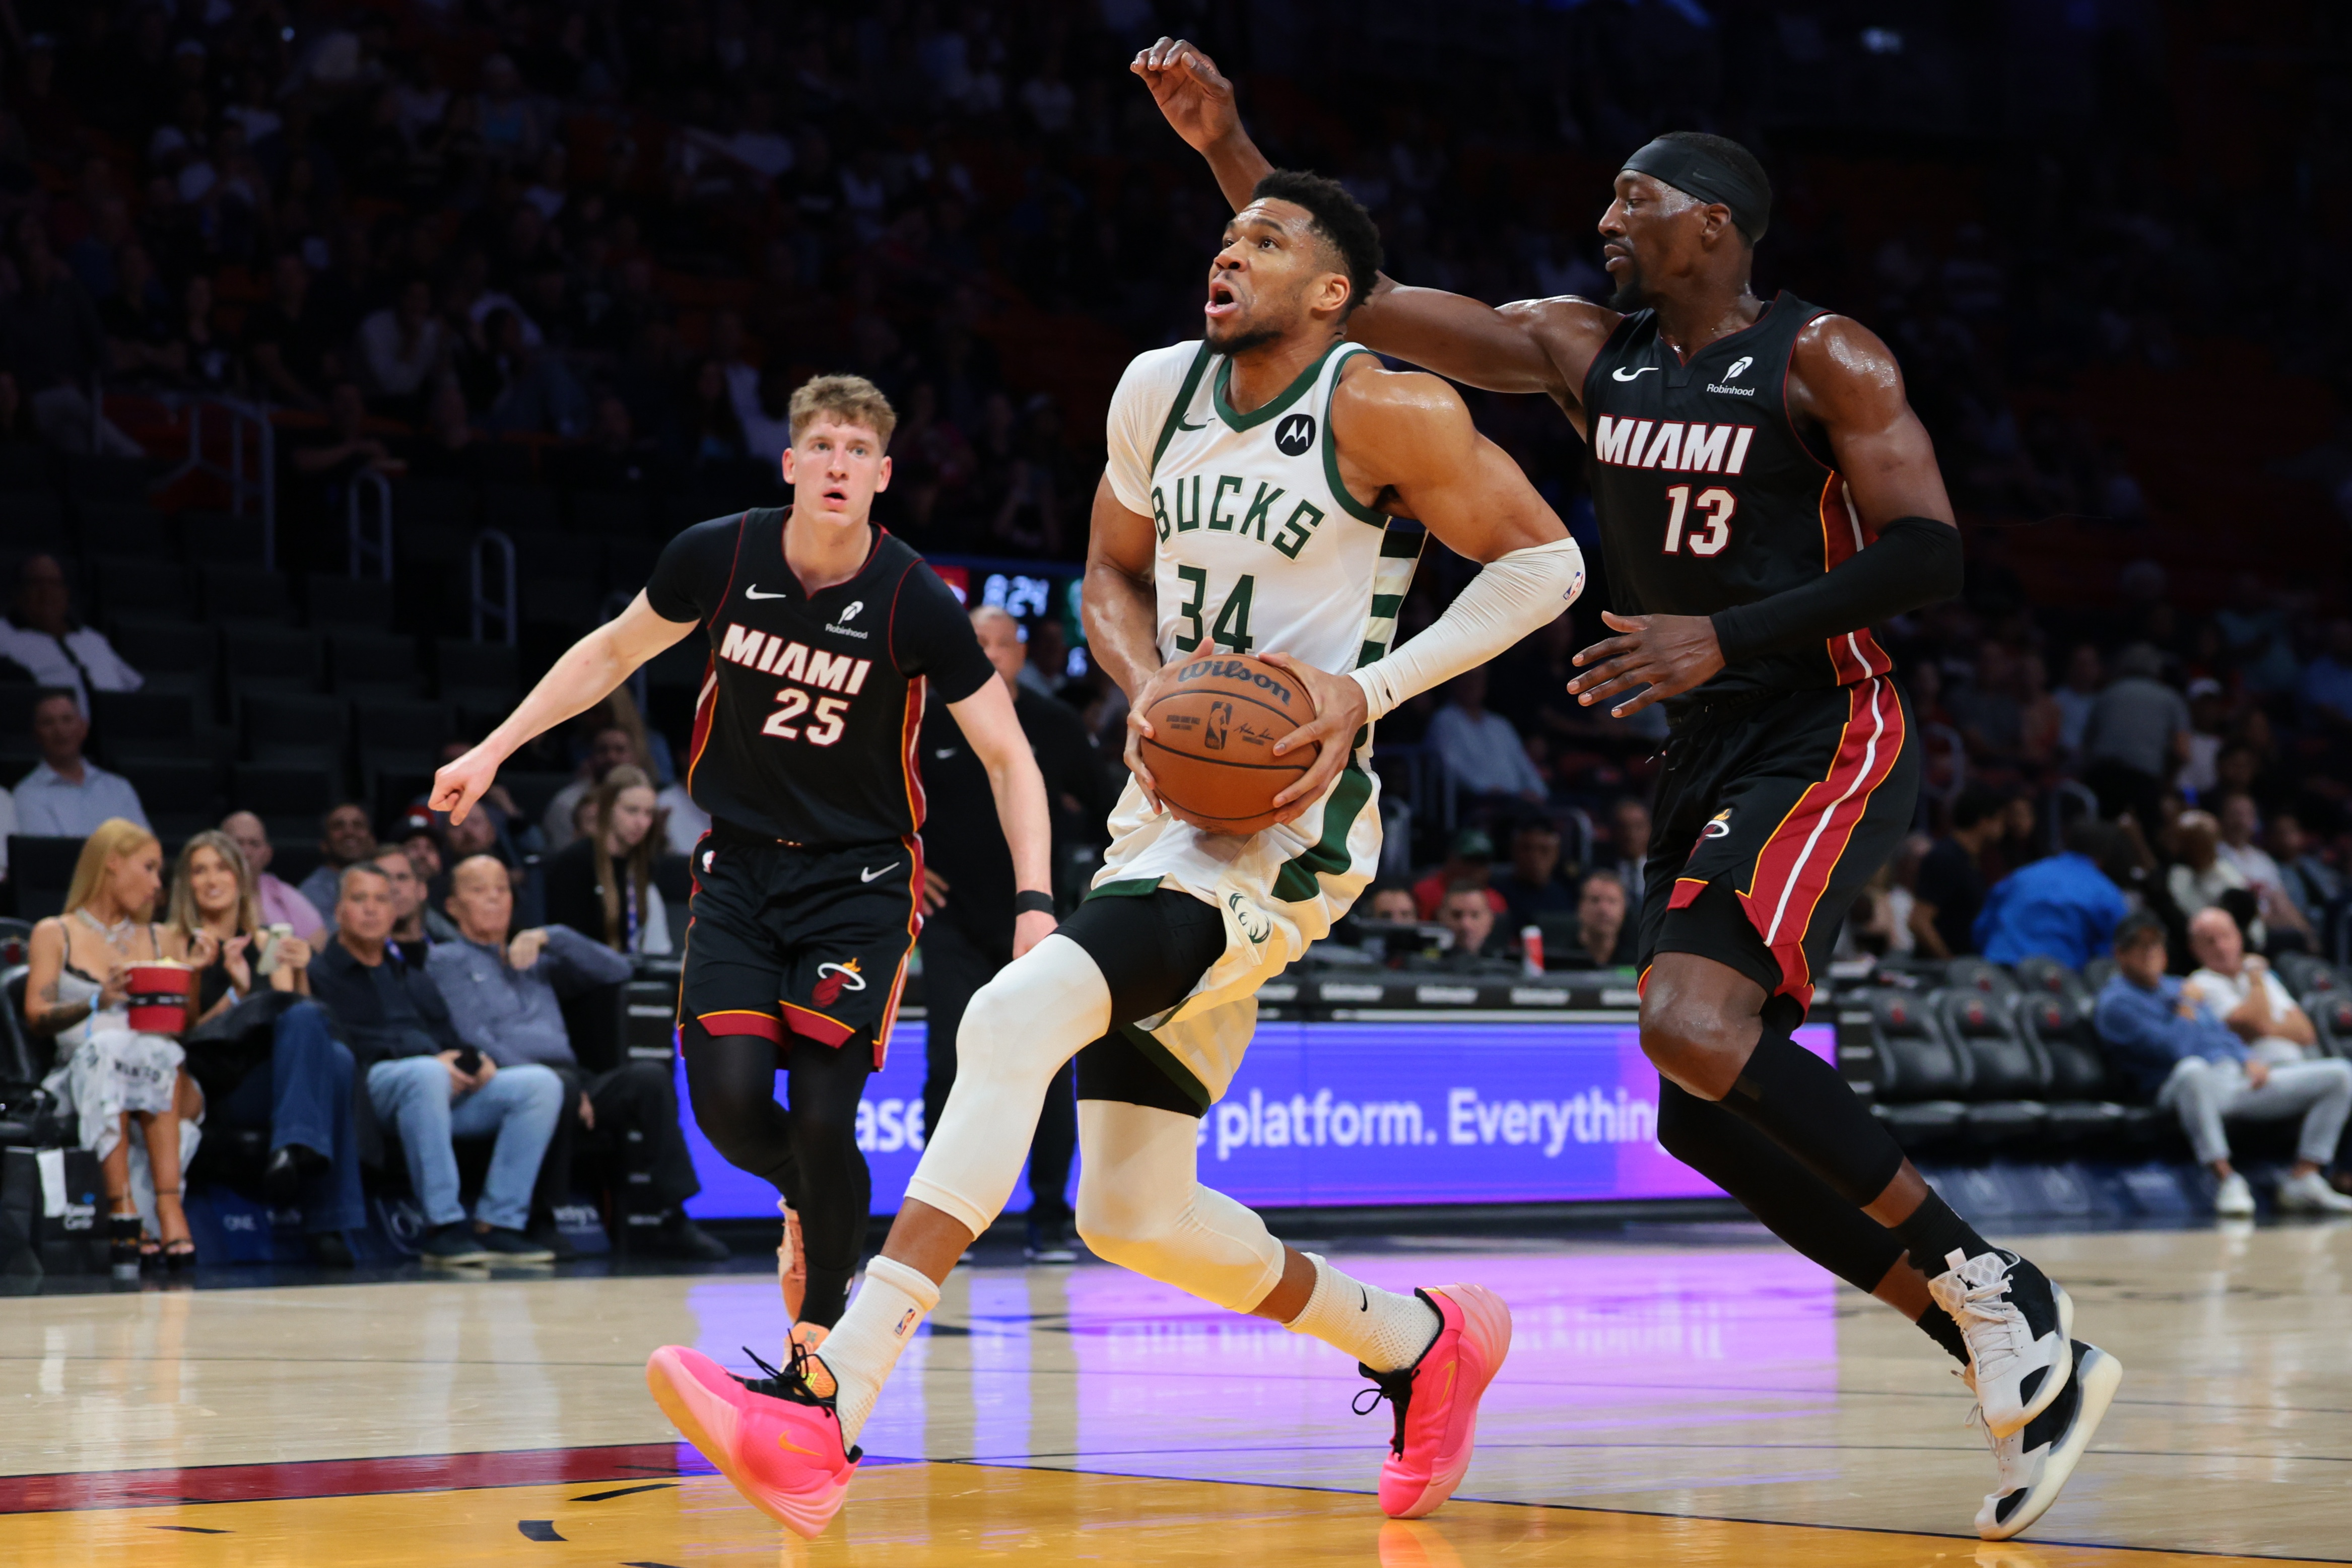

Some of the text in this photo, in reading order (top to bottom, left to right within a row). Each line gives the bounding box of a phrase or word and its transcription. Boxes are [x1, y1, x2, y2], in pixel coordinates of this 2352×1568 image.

[1706, 383, 1755, 396] Robinhood
[1595, 413, 1757, 476] MIAMI
[1151, 474, 1327, 563] BUCKS
[1662, 484, 1738, 557] 13
[825, 623, 868, 639] Robinhood
[1175, 563, 1256, 654] 34
[719, 622, 873, 696] MIAMI
[1178, 660, 1292, 706] Wilson
[760, 687, 851, 746] 25
[1216, 1087, 1438, 1161] platform.
[1448, 1085, 1671, 1157] Everythin
